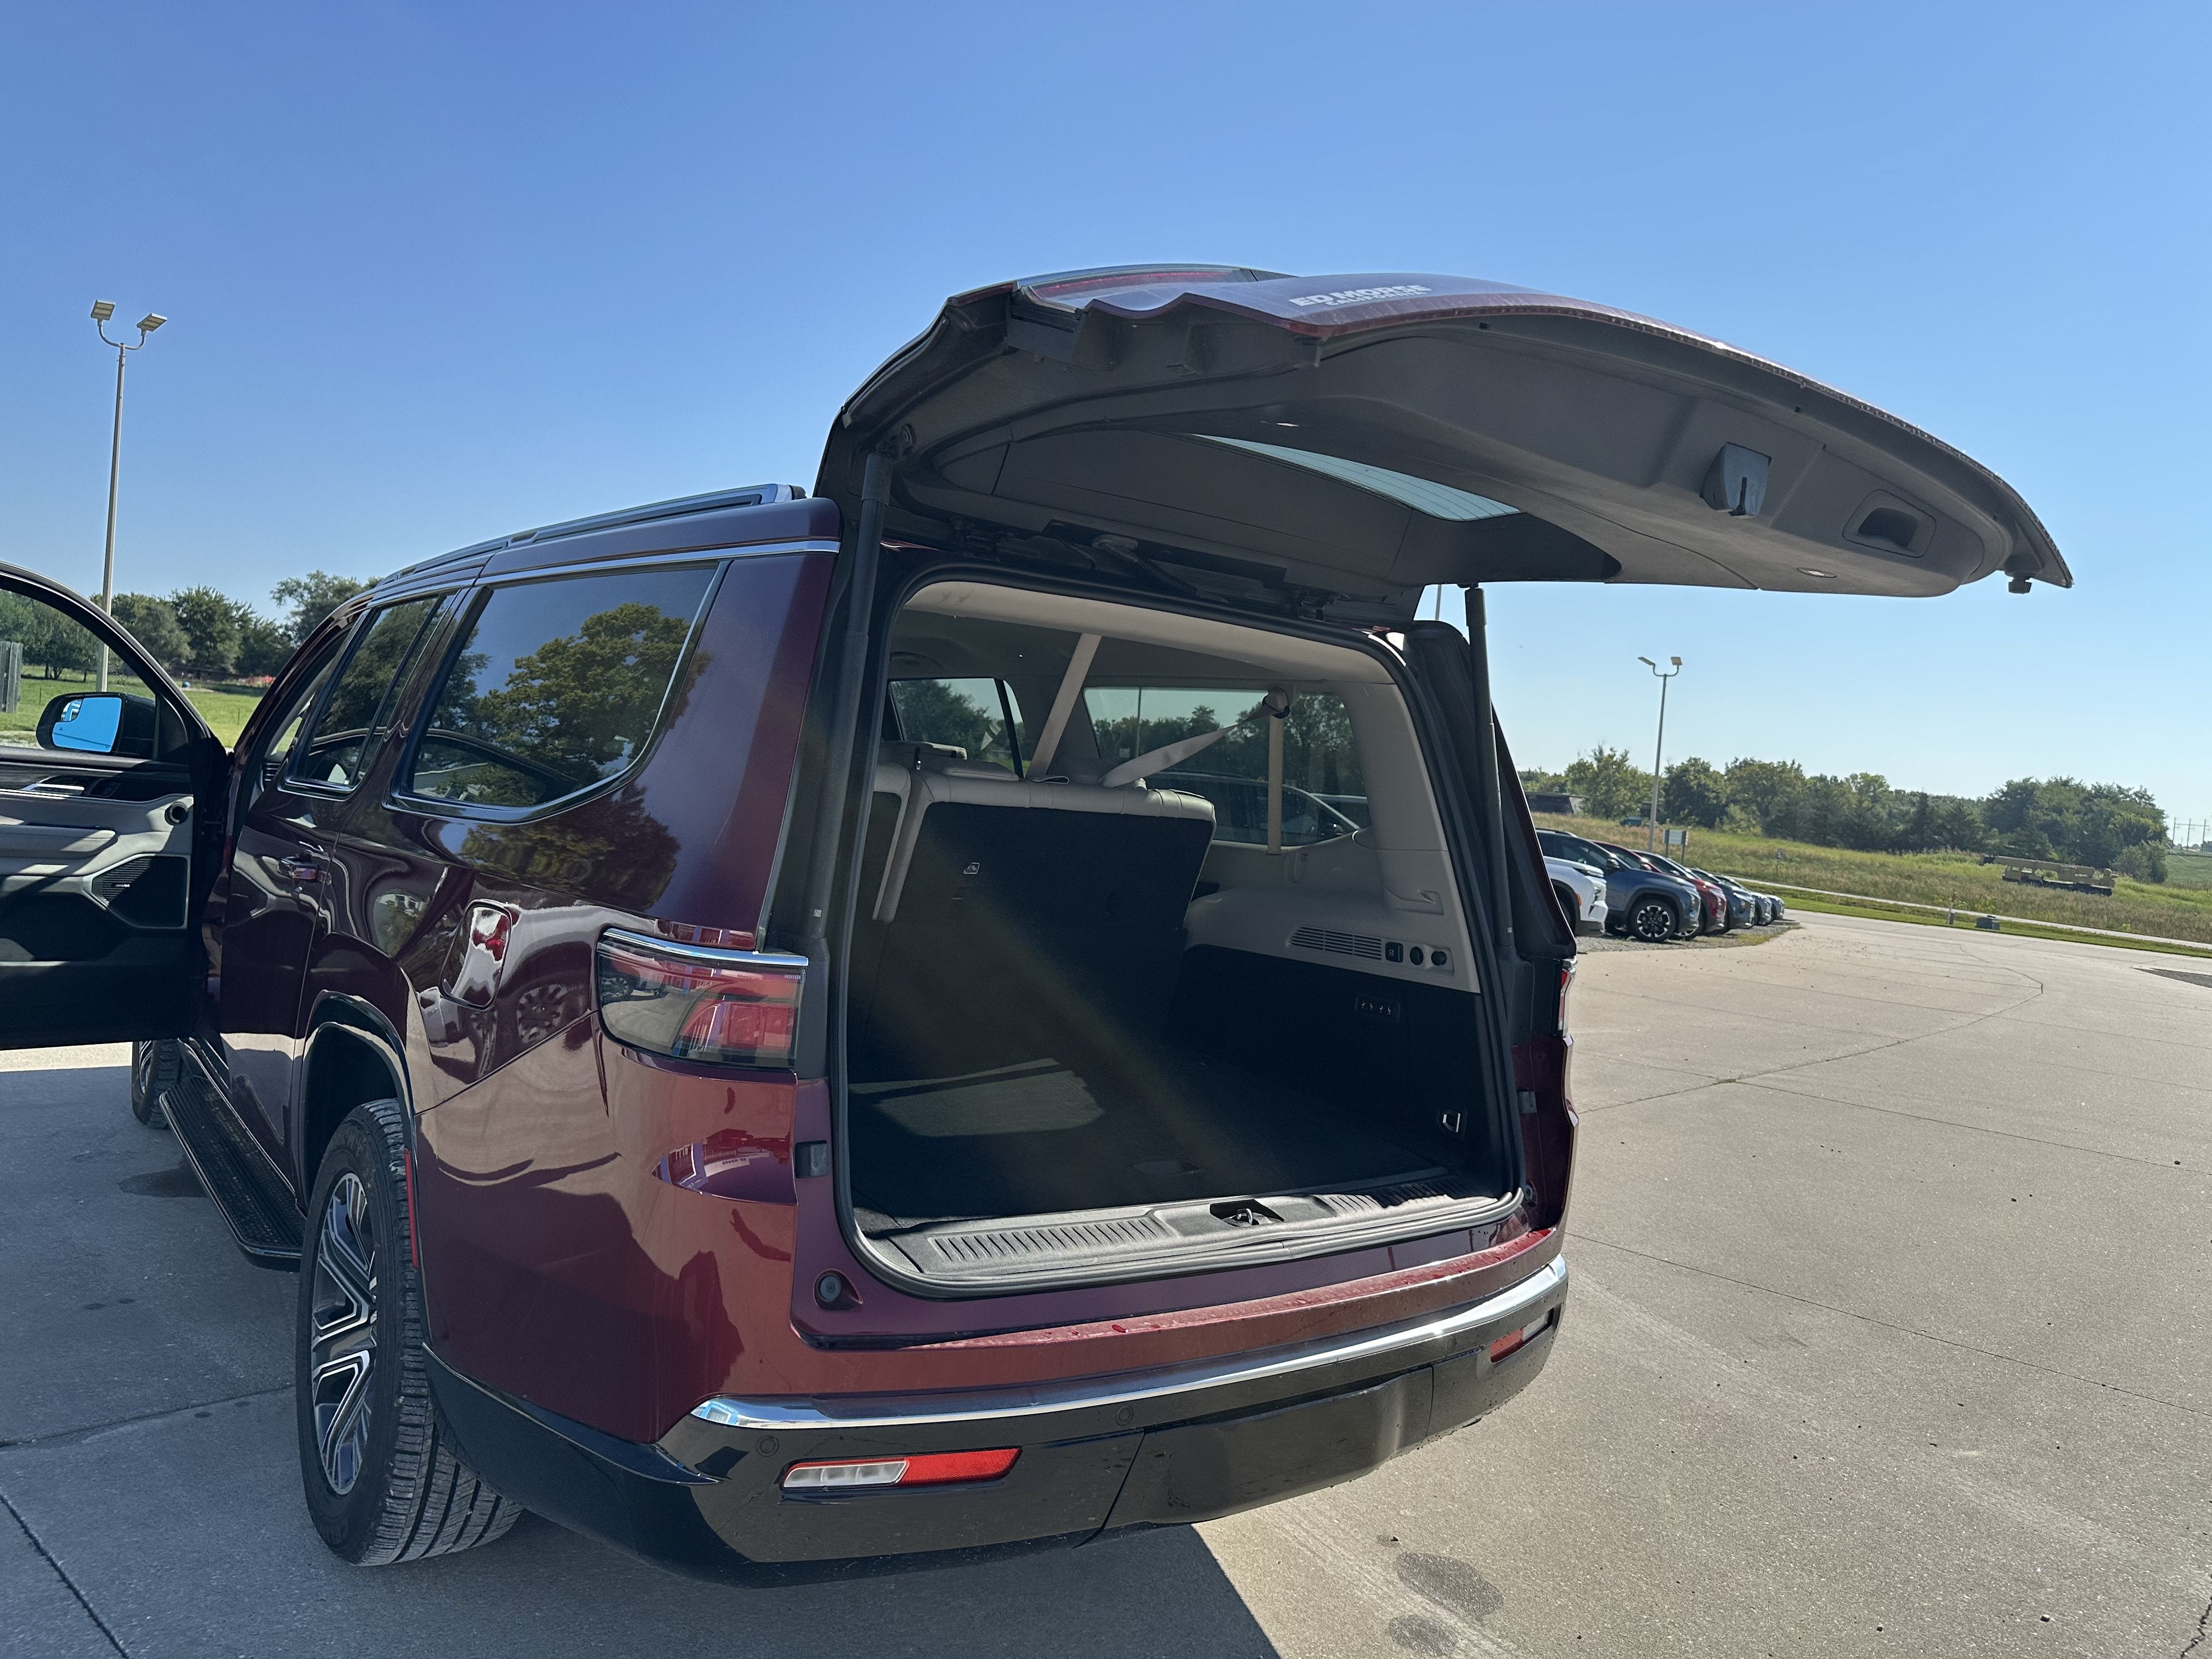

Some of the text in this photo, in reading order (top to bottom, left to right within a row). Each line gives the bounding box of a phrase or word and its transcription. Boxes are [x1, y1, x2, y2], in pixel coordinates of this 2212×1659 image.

[1288, 285, 1432, 306] ED MORSE
[1325, 292, 1427, 306] CALIFORNIA
